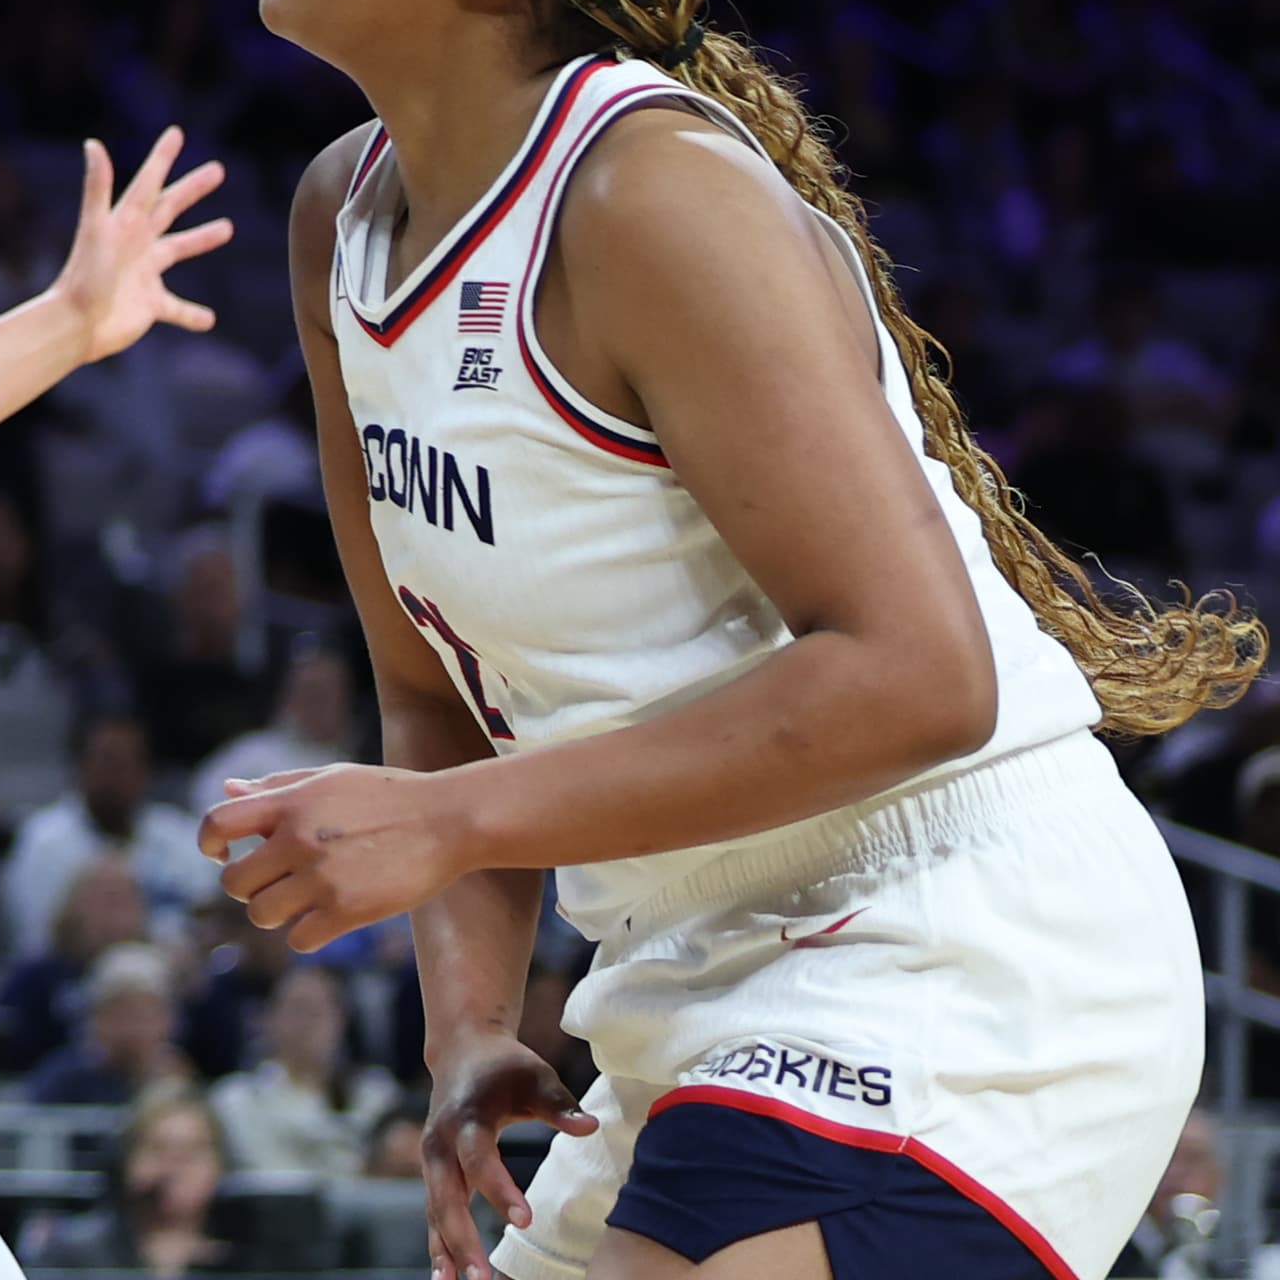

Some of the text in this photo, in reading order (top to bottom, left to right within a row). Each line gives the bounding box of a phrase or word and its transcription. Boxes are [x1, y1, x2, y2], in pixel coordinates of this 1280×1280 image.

[457, 366, 503, 384] EAST
[462, 347, 494, 365] BIG
[361, 423, 495, 546] CONN
[398, 585, 516, 740] 2
